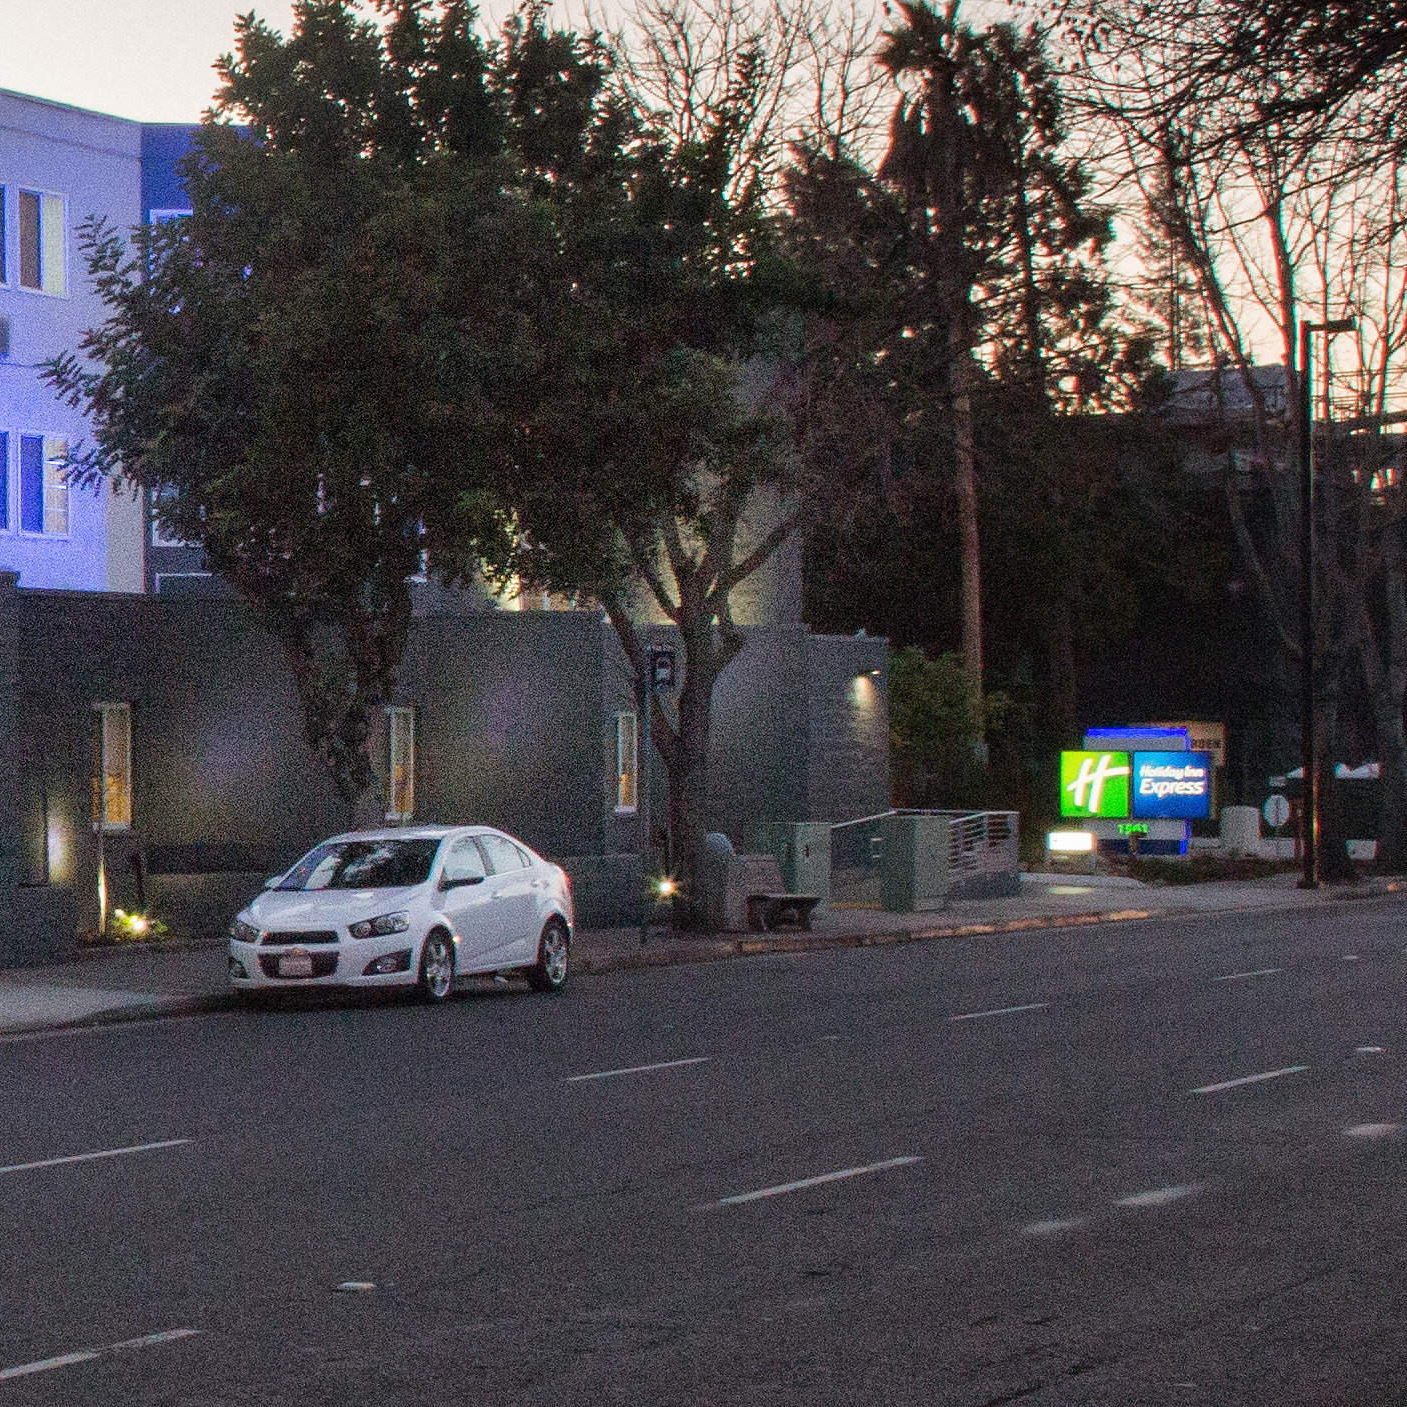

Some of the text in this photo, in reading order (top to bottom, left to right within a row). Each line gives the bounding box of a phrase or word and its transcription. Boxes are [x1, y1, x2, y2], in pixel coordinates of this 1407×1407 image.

[1139, 764, 1204, 779] Holiday Inn
[1139, 779, 1204, 797] Express
